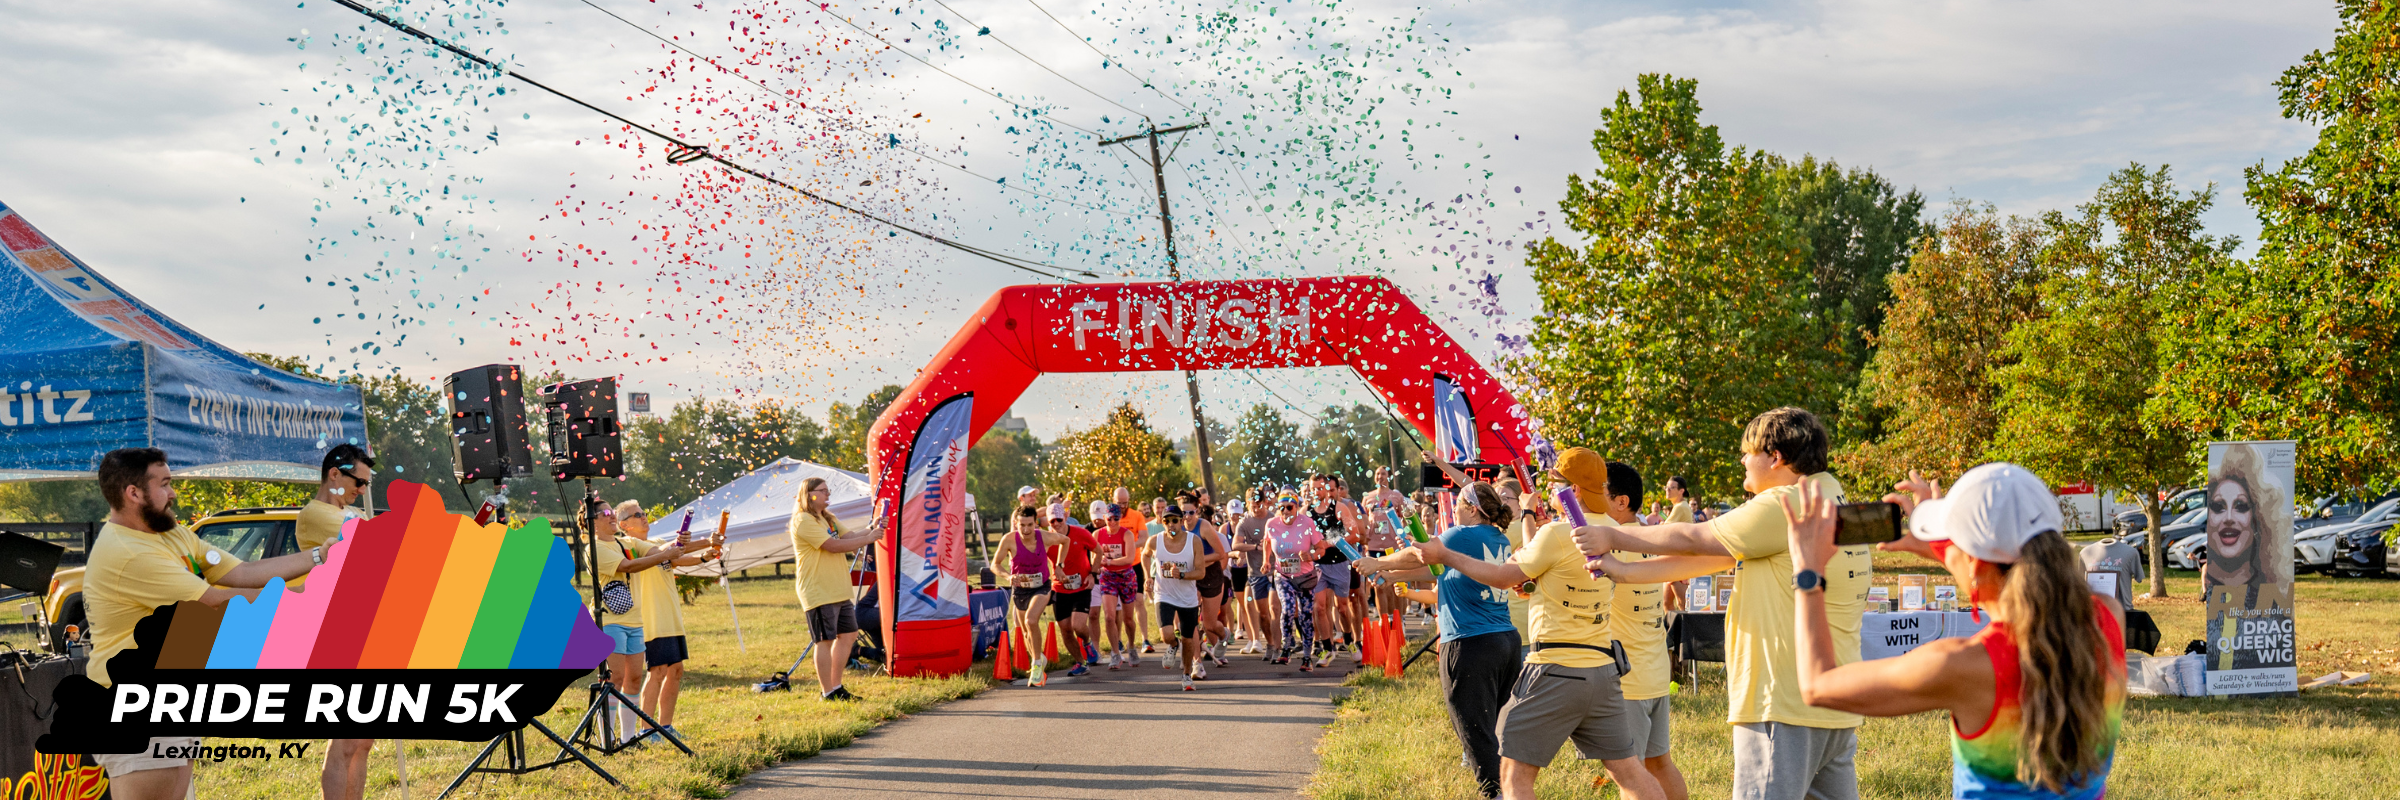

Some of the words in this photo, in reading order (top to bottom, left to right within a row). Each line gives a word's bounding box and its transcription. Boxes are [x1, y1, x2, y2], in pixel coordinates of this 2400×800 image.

[1073, 297, 1311, 350] FINISH
[184, 384, 244, 432] EVENT
[246, 398, 345, 439] INFORMATION
[942, 439, 963, 504] Group
[938, 512, 960, 578] Timing
[2229, 607, 2244, 617] like
[2246, 610, 2262, 619] you
[2264, 605, 2284, 615] stole
[1890, 617, 1919, 630] RUN
[2243, 619, 2293, 635] DRAG
[1885, 633, 1919, 647] WITH
[2256, 648, 2293, 664] WIG
[2213, 681, 2245, 690] Saturdays
[2254, 678, 2292, 688] Wednesdays
[2219, 674, 2248, 682] LGBTQ+
[2251, 672, 2286, 680] walks/runs
